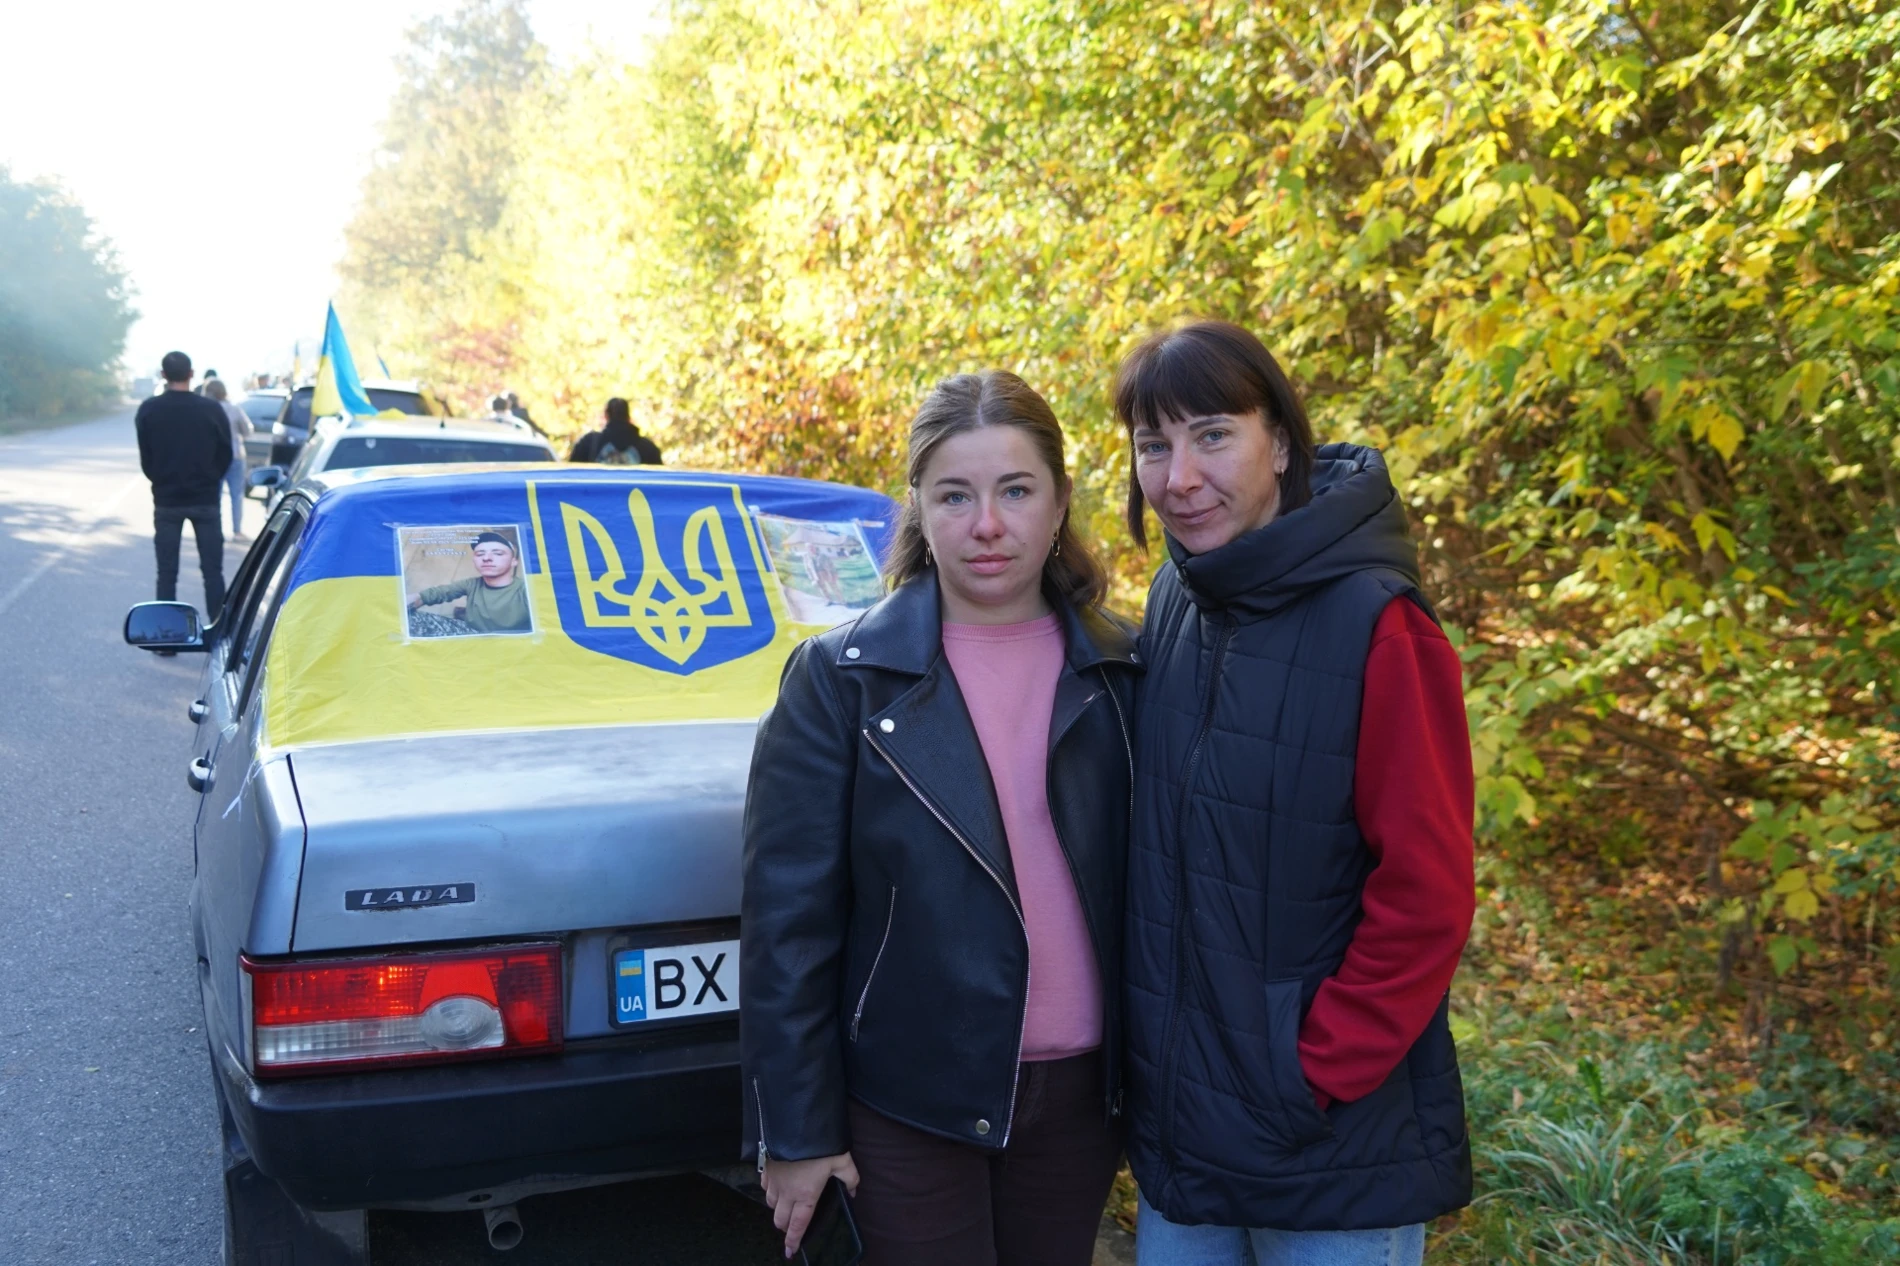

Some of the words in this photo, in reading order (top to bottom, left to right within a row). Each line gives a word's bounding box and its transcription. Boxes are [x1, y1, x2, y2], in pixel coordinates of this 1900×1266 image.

[361, 886, 458, 906] LADA
[653, 952, 728, 1010] BX
[620, 995, 644, 1013] UA
